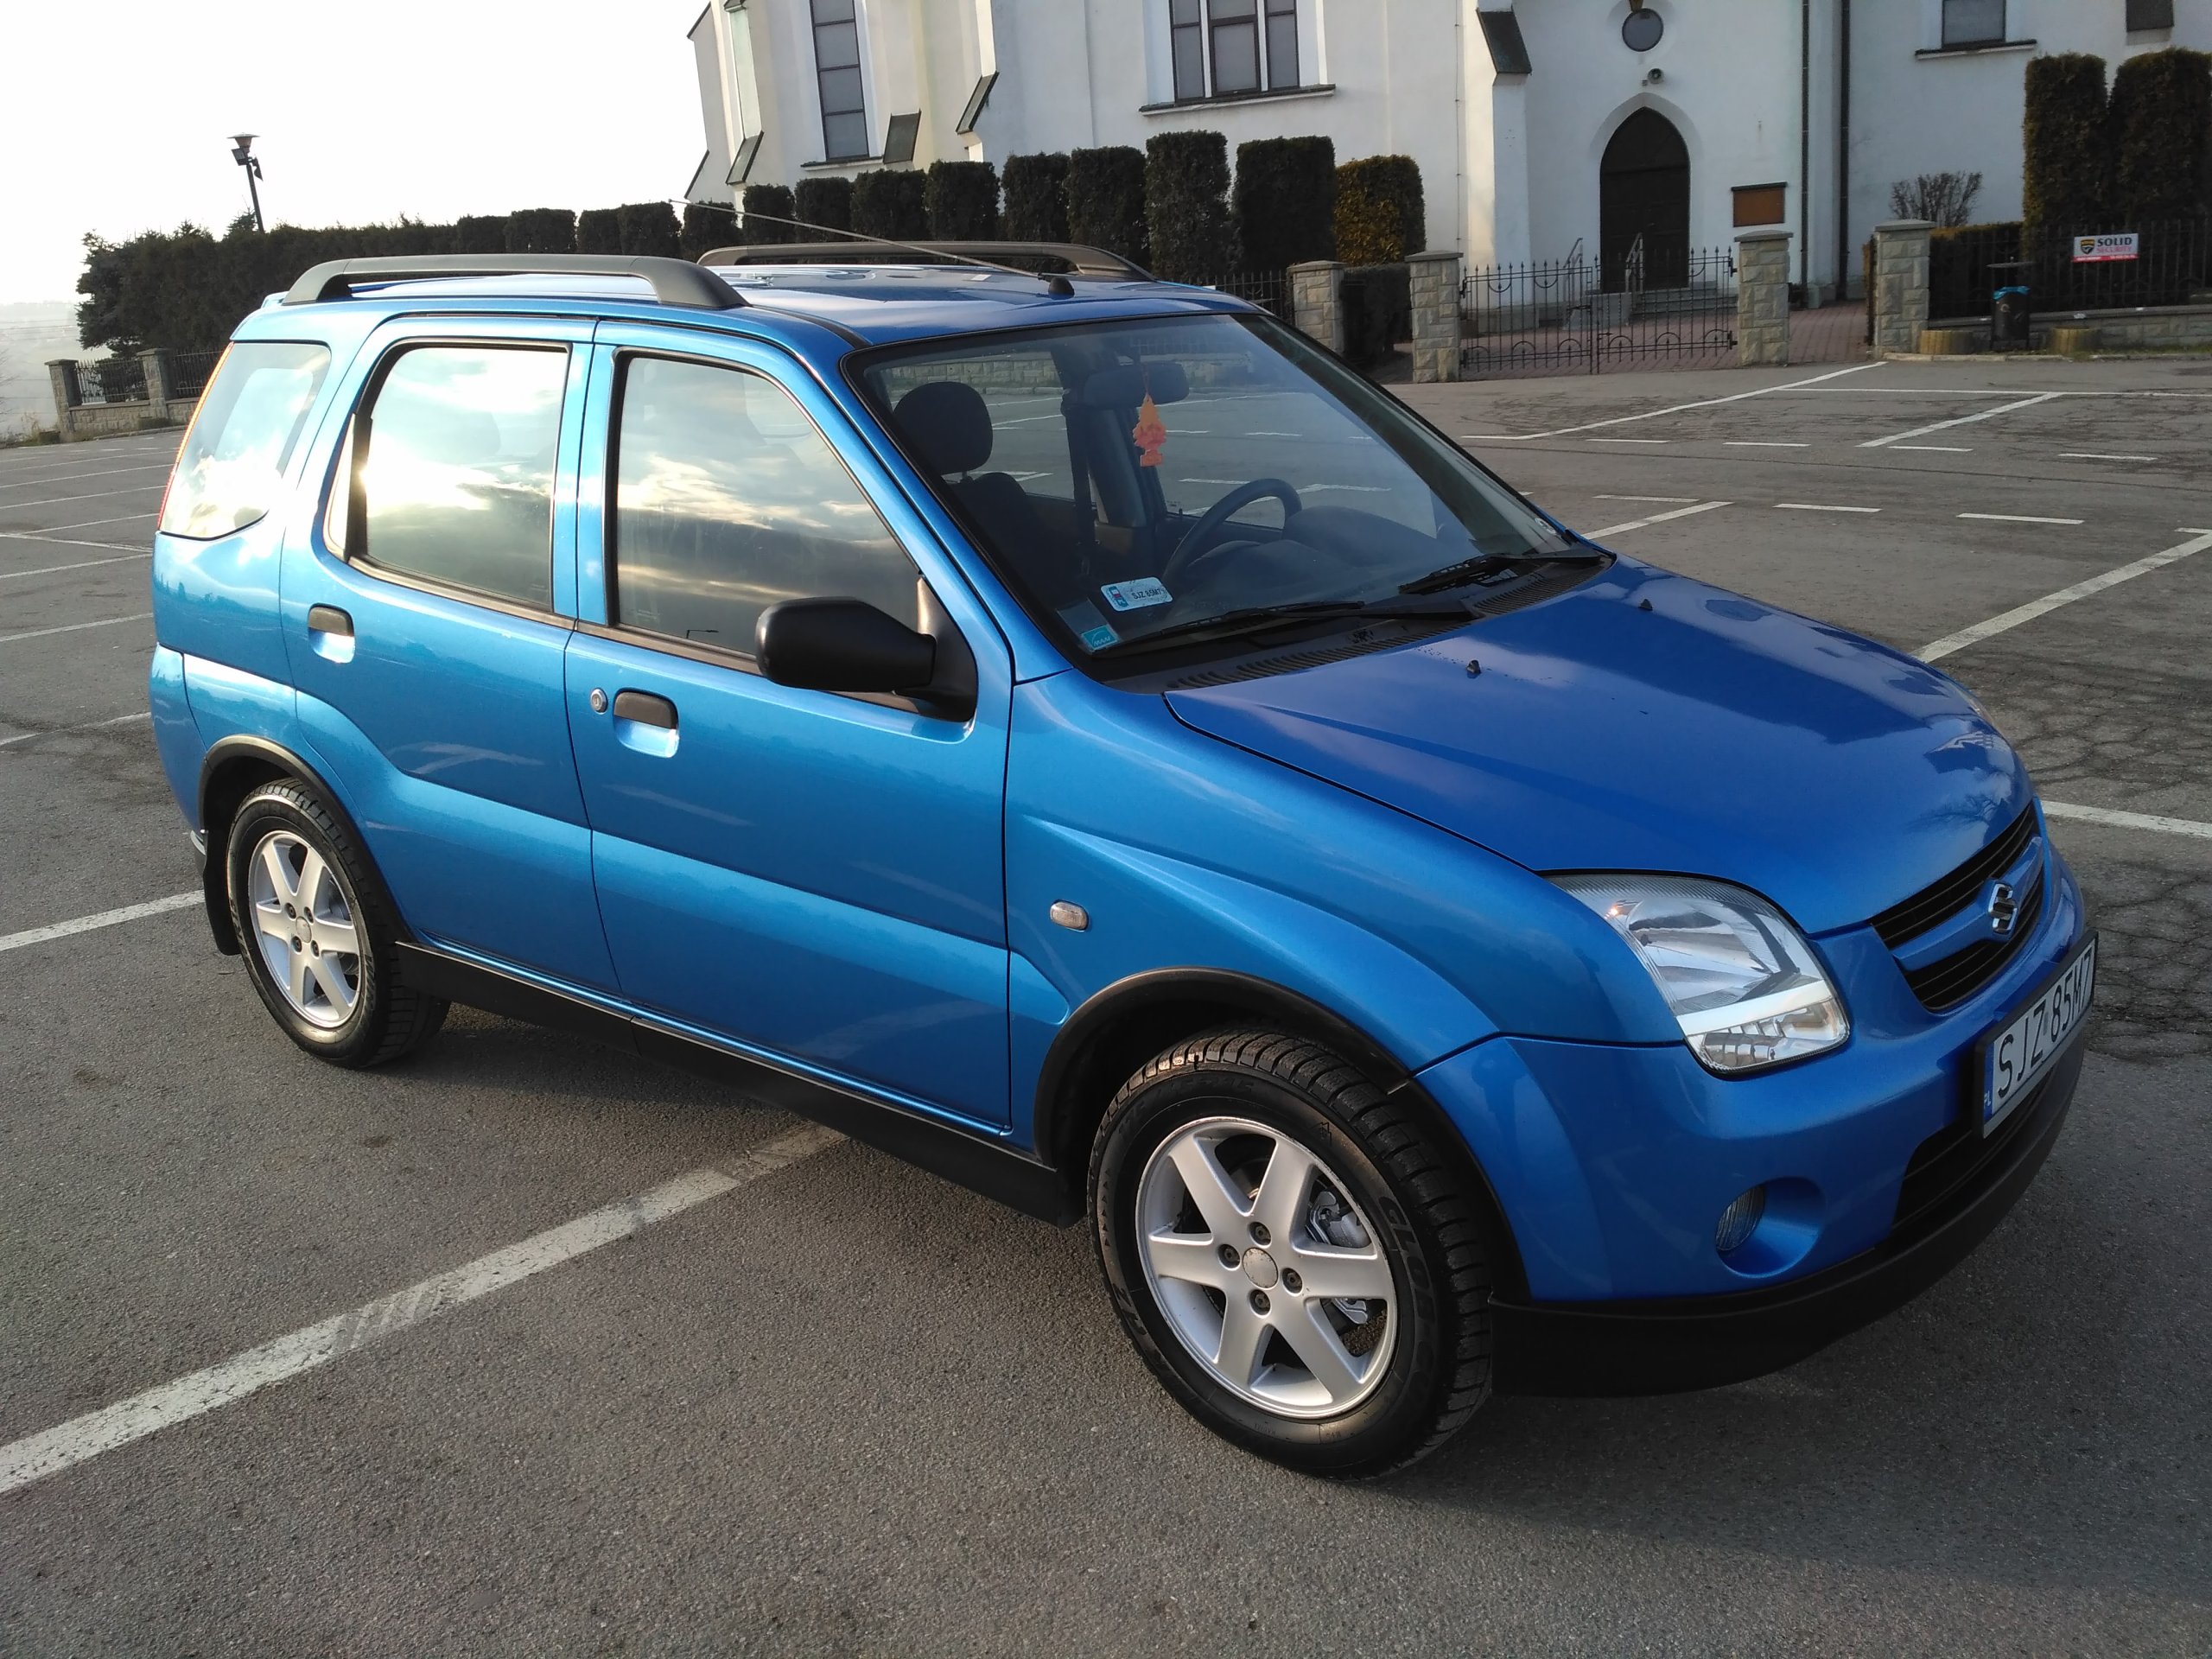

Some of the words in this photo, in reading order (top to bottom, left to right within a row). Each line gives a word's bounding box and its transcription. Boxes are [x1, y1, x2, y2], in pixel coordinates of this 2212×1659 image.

[2097, 237, 2133, 246] SOLID
[1131, 591, 1146, 600] SJZ
[1146, 588, 1161, 598] 85M7
[1998, 1000, 2046, 1098] SJZ
[2050, 949, 2092, 1042] 85M7
[1984, 1091, 1992, 1106] PL
